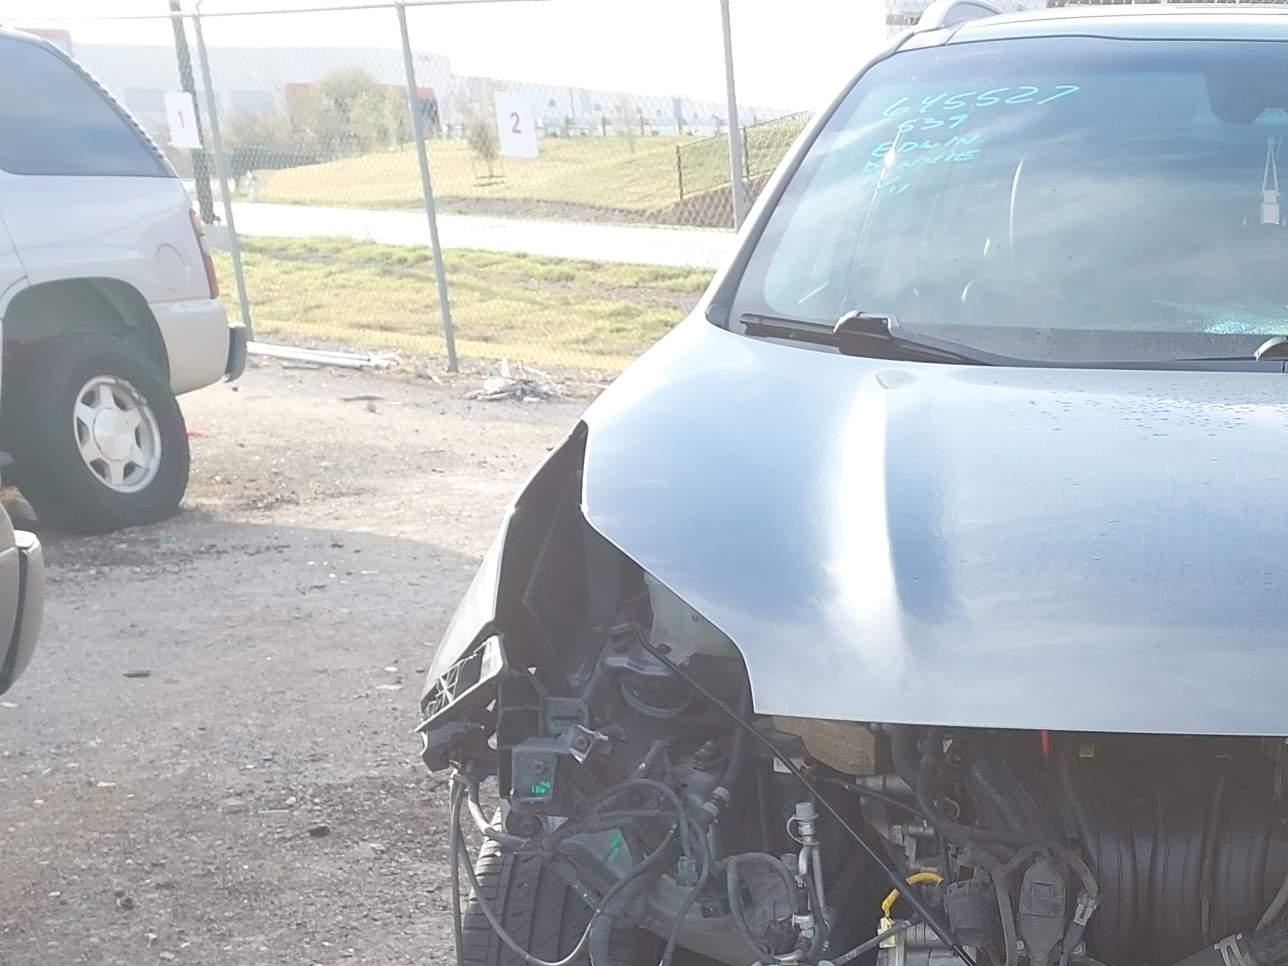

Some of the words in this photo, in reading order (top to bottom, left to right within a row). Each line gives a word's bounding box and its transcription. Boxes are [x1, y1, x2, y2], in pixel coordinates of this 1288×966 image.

[883, 84, 1080, 118] 645527
[177, 110, 185, 129] 1
[509, 111, 522, 134] 2
